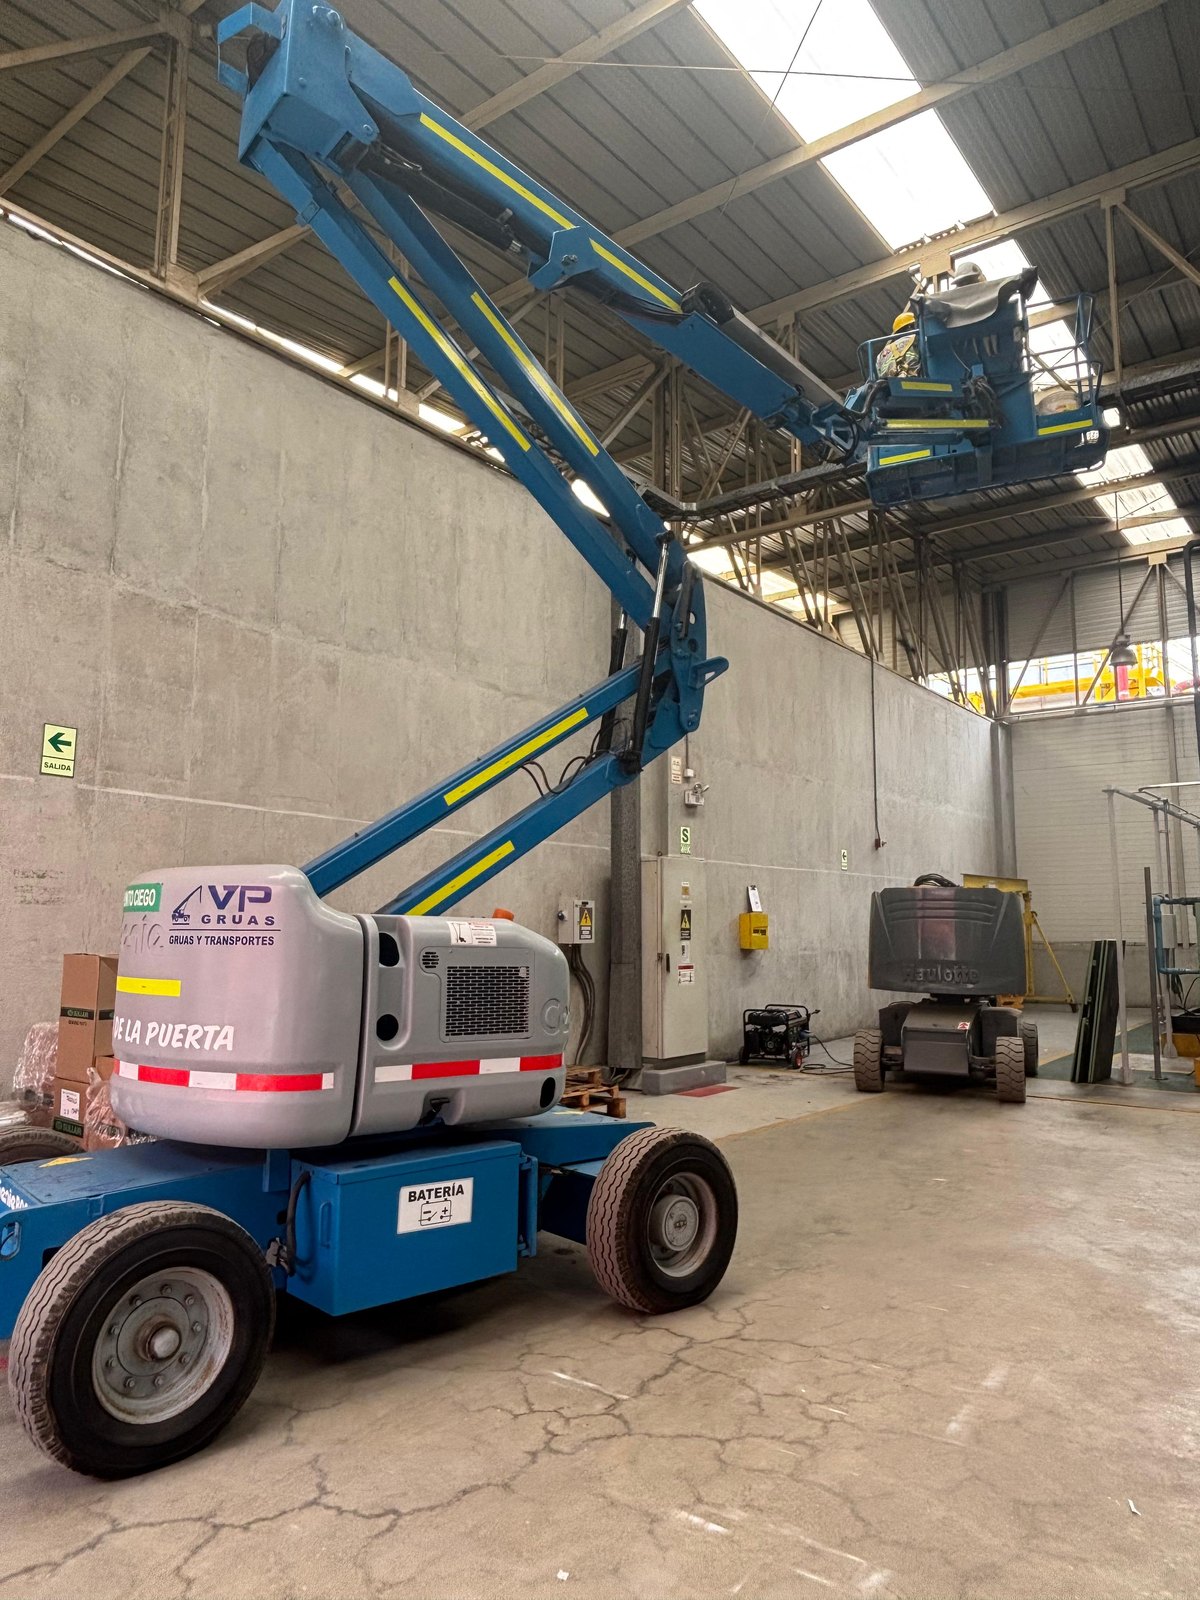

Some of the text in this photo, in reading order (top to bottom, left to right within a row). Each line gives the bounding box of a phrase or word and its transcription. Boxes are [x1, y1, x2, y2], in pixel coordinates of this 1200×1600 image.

[44, 761, 71, 772] SALIDA
[682, 828, 689, 843] S
[134, 888, 156, 907] CIEGO
[208, 885, 272, 912] VP
[201, 914, 275, 926] GRUAS
[169, 935, 274, 946] GRUAS Y TRANSPORTES
[125, 1019, 141, 1045] LA
[145, 1021, 235, 1051] PUERTA
[408, 1182, 465, 1203] BATERÍA
